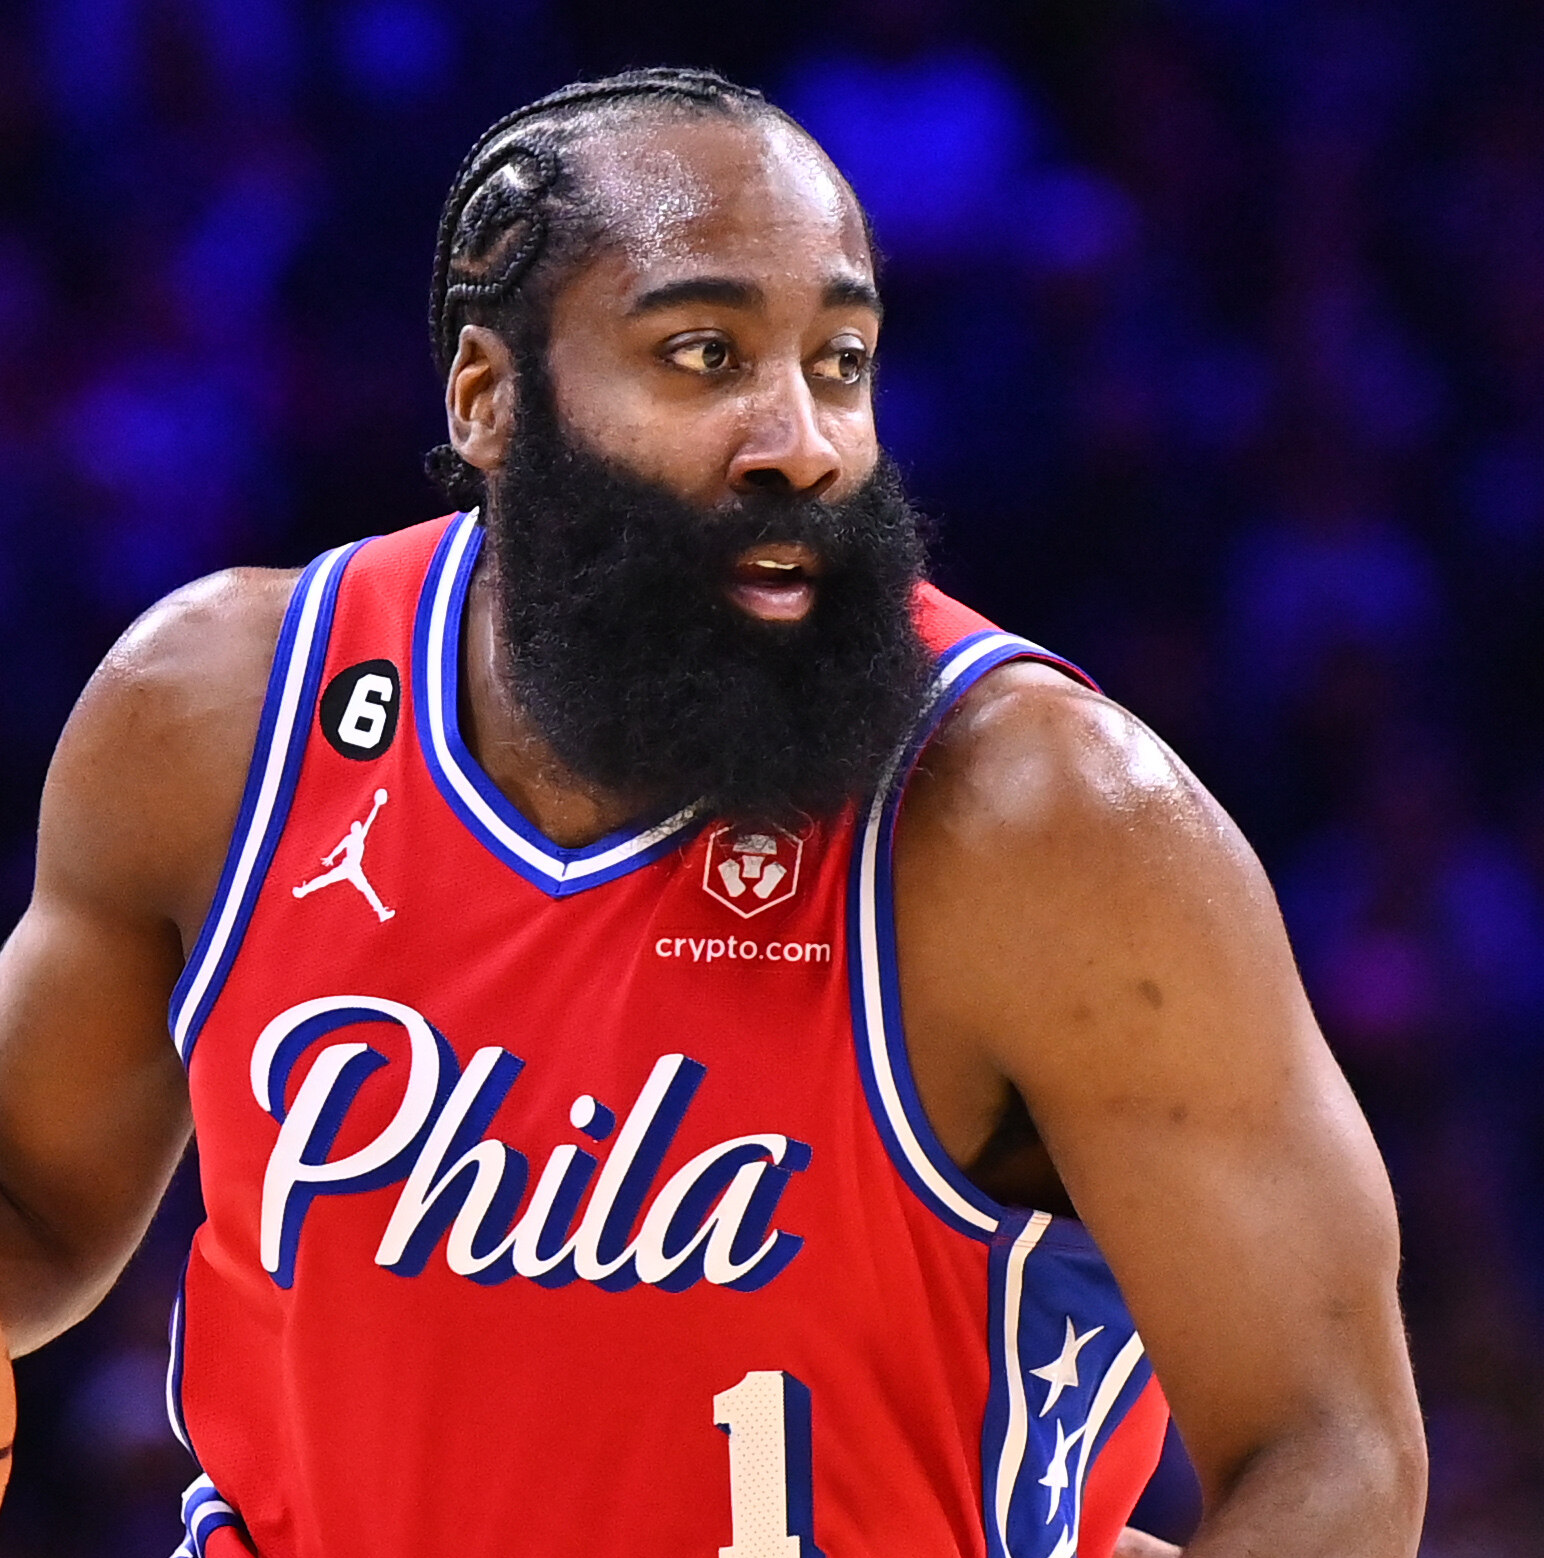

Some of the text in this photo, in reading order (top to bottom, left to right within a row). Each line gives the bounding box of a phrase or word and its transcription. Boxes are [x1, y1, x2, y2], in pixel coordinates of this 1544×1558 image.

[337, 673, 394, 749] 6
[655, 935, 831, 963] crypto.com
[250, 995, 813, 1293] Phila
